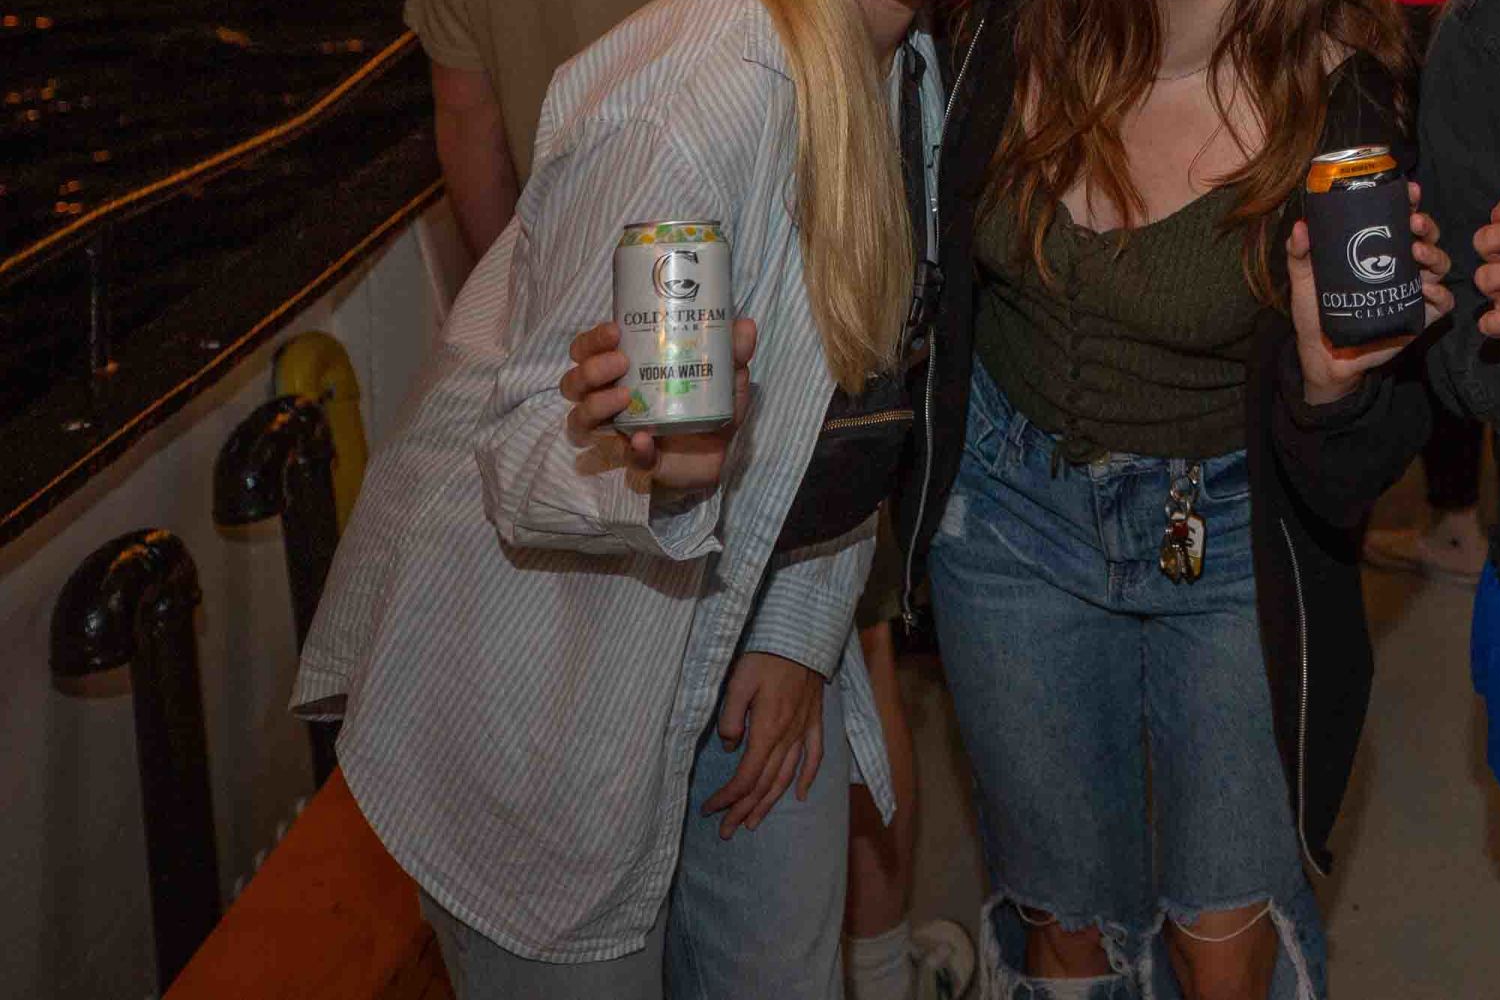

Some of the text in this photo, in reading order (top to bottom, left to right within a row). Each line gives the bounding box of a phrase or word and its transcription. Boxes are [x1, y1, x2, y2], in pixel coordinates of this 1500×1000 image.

[1322, 278, 1422, 308] COLDSTREAM
[624, 307, 726, 326] COLDTREAM
[1355, 303, 1405, 319] CLEAR
[639, 363, 714, 382] VODKA WATER
